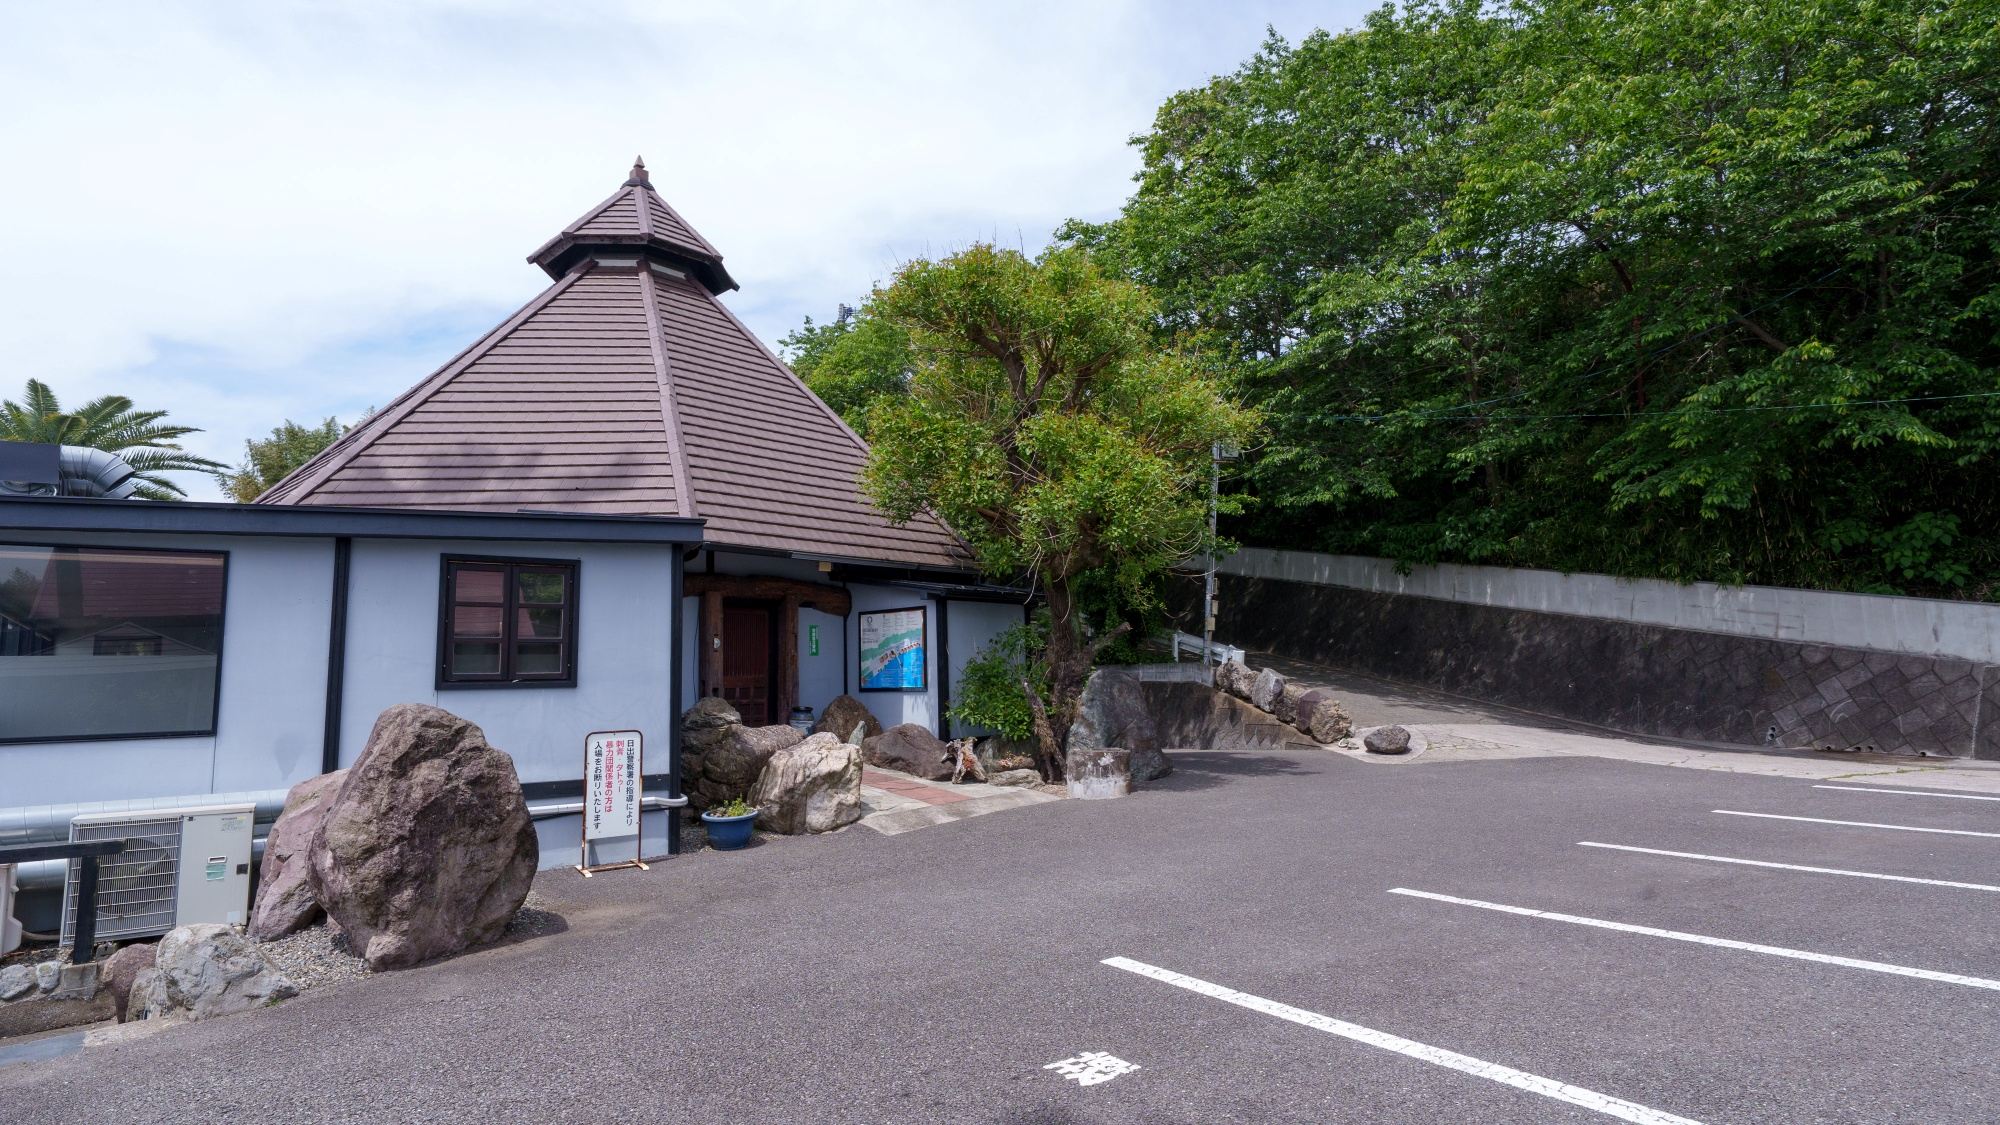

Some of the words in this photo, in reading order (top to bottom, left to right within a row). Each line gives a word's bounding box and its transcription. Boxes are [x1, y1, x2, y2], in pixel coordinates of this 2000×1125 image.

[604, 740, 614, 813] 暴力団関係者の方は
[626, 739, 635, 826] 日出警察署の指導により
